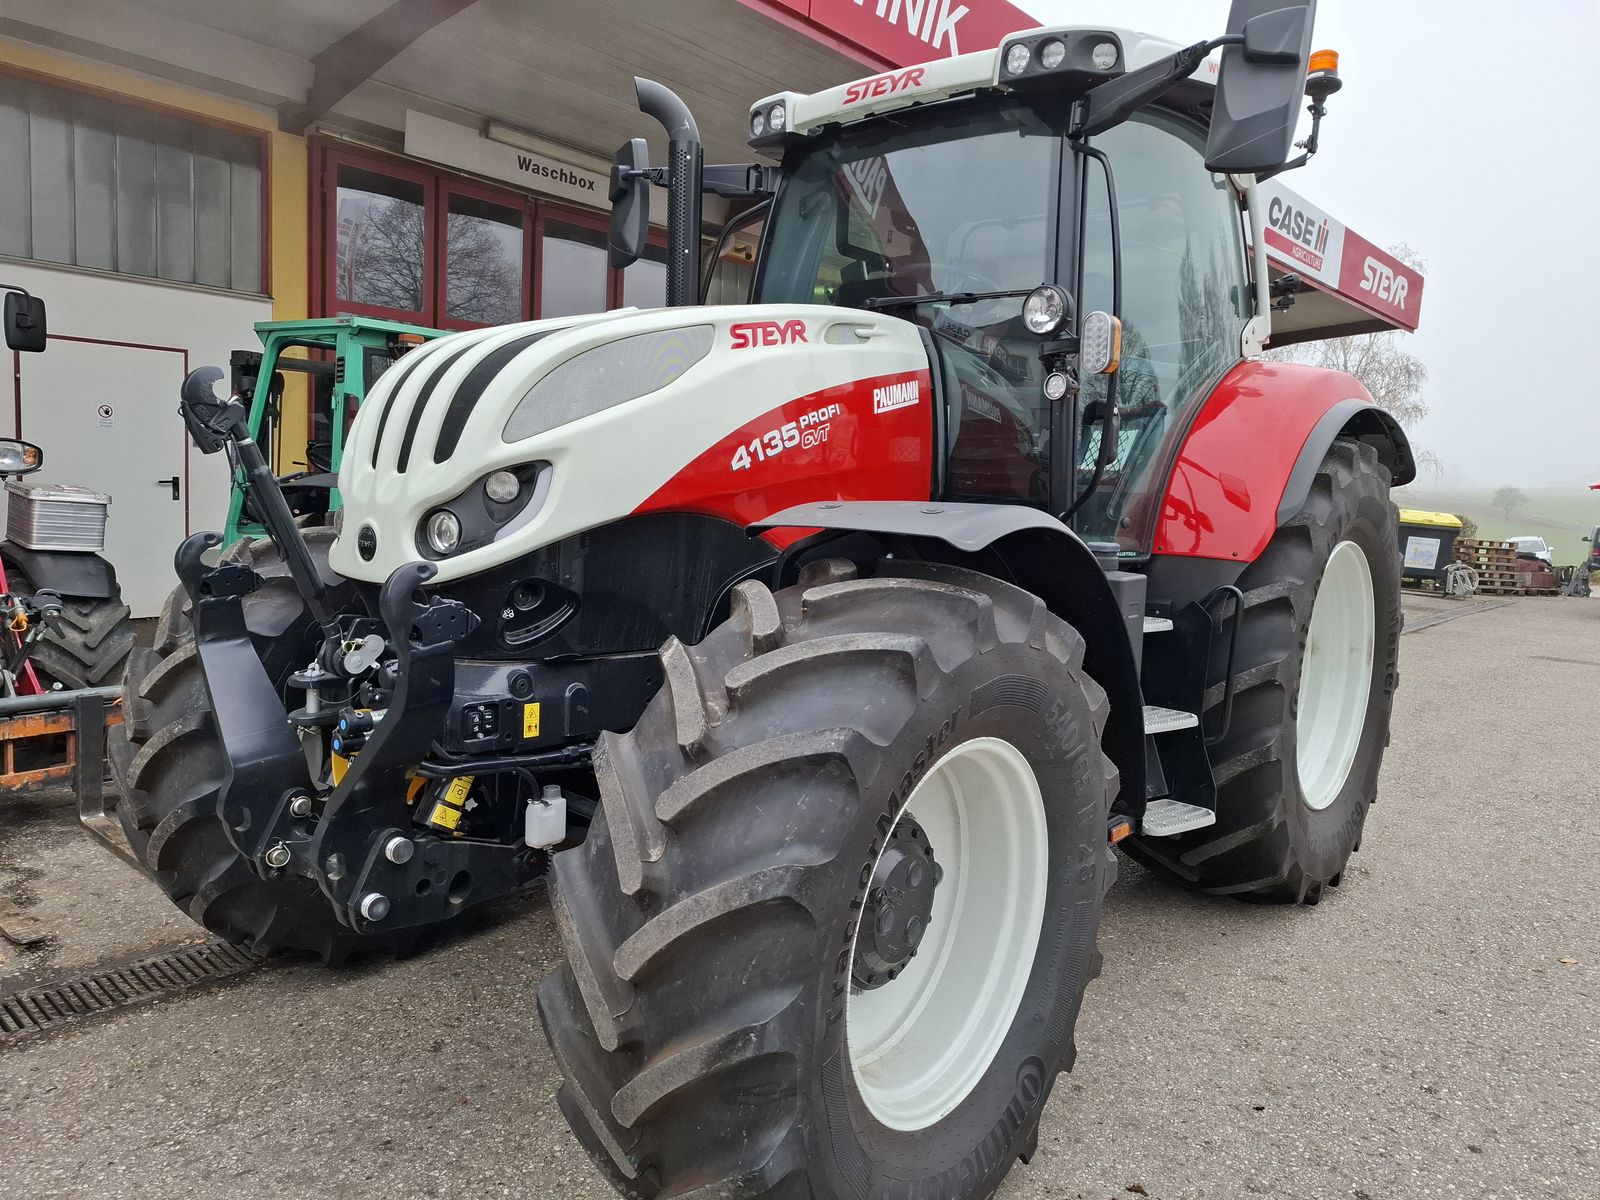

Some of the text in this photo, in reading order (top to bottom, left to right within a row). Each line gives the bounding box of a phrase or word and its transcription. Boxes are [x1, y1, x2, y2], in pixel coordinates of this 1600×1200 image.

[842, 67, 926, 105] STEYR
[516, 154, 596, 191] Waschbox
[1268, 196, 1316, 247] CASE
[1291, 246, 1322, 271] AGRICULTURE
[1359, 255, 1409, 310] STEYR
[729, 319, 810, 350] STEYR
[873, 379, 920, 415] PAUMANN
[731, 403, 841, 472] 4135 PROFI
[801, 422, 831, 449] CVT
